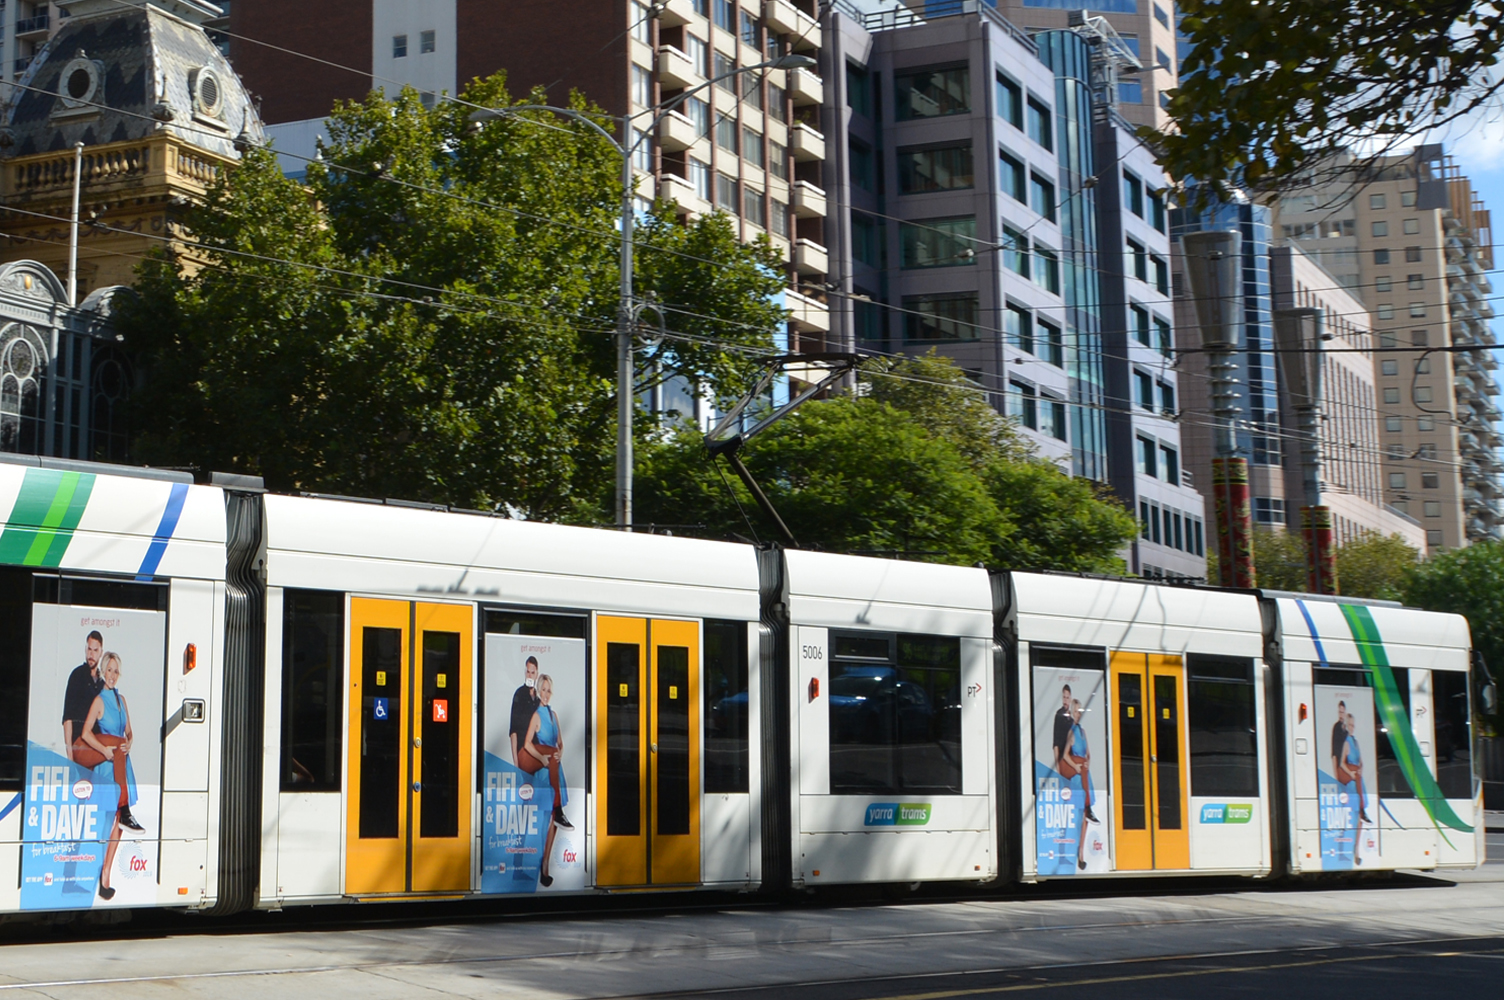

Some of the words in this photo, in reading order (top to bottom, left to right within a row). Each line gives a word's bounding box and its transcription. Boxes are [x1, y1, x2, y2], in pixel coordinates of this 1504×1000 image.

[802, 645, 823, 660] 5006
[30, 766, 70, 802] FIFI
[487, 772, 516, 802] FIFI
[1038, 777, 1060, 802] FIFI
[27, 806, 39, 827] &
[40, 804, 98, 841] DAVE
[486, 806, 494, 823] &
[495, 804, 539, 835] DAVE
[869, 808, 893, 823] yarra
[901, 806, 927, 820] trams
[1045, 803, 1076, 829] DAVE
[1202, 808, 1223, 822] yarra
[1228, 807, 1249, 819] trams
[71, 853, 96, 863] weekdays
[129, 855, 148, 871] fox
[562, 849, 577, 863] fox
